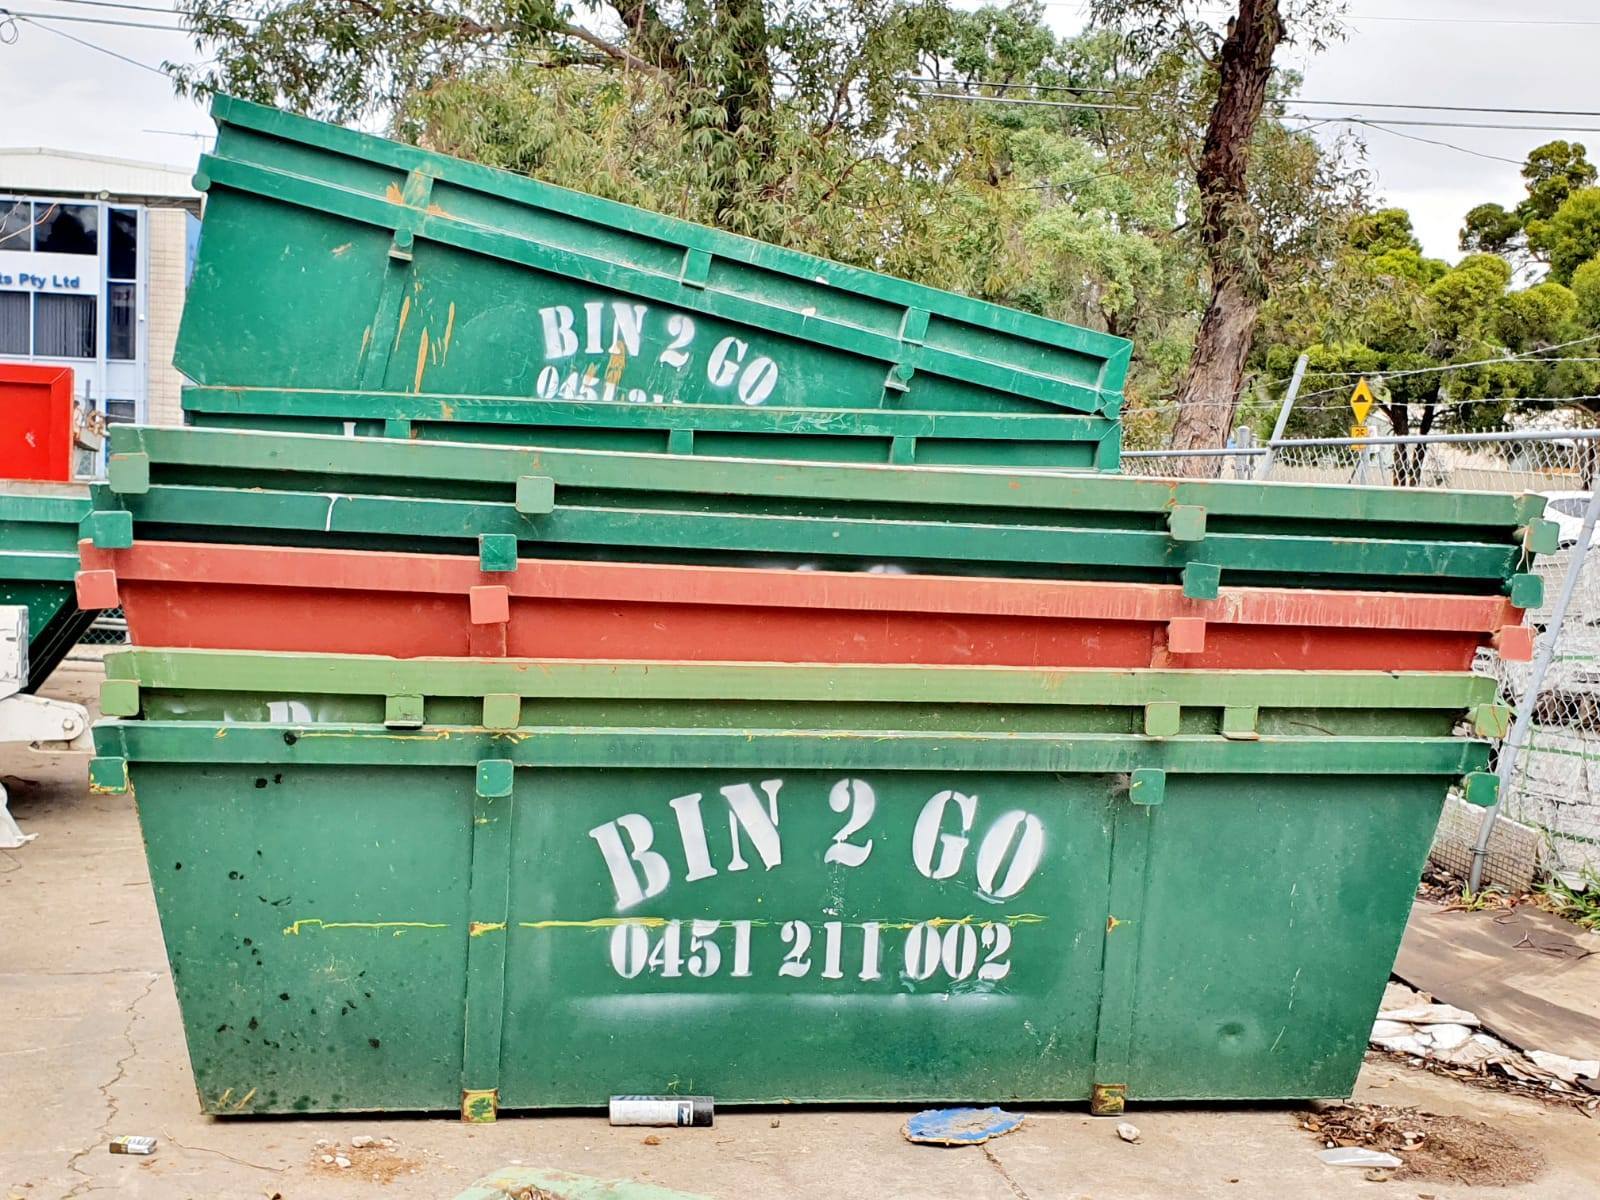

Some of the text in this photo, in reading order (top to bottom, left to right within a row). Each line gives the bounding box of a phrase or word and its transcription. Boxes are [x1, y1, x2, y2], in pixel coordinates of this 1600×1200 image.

[19, 273, 46, 289] Pty
[52, 275, 80, 288] Ltd
[538, 302, 780, 406] BIN 2 GO
[588, 778, 1046, 911] BIN 2 GO
[609, 919, 1013, 982] 0451 211 002
